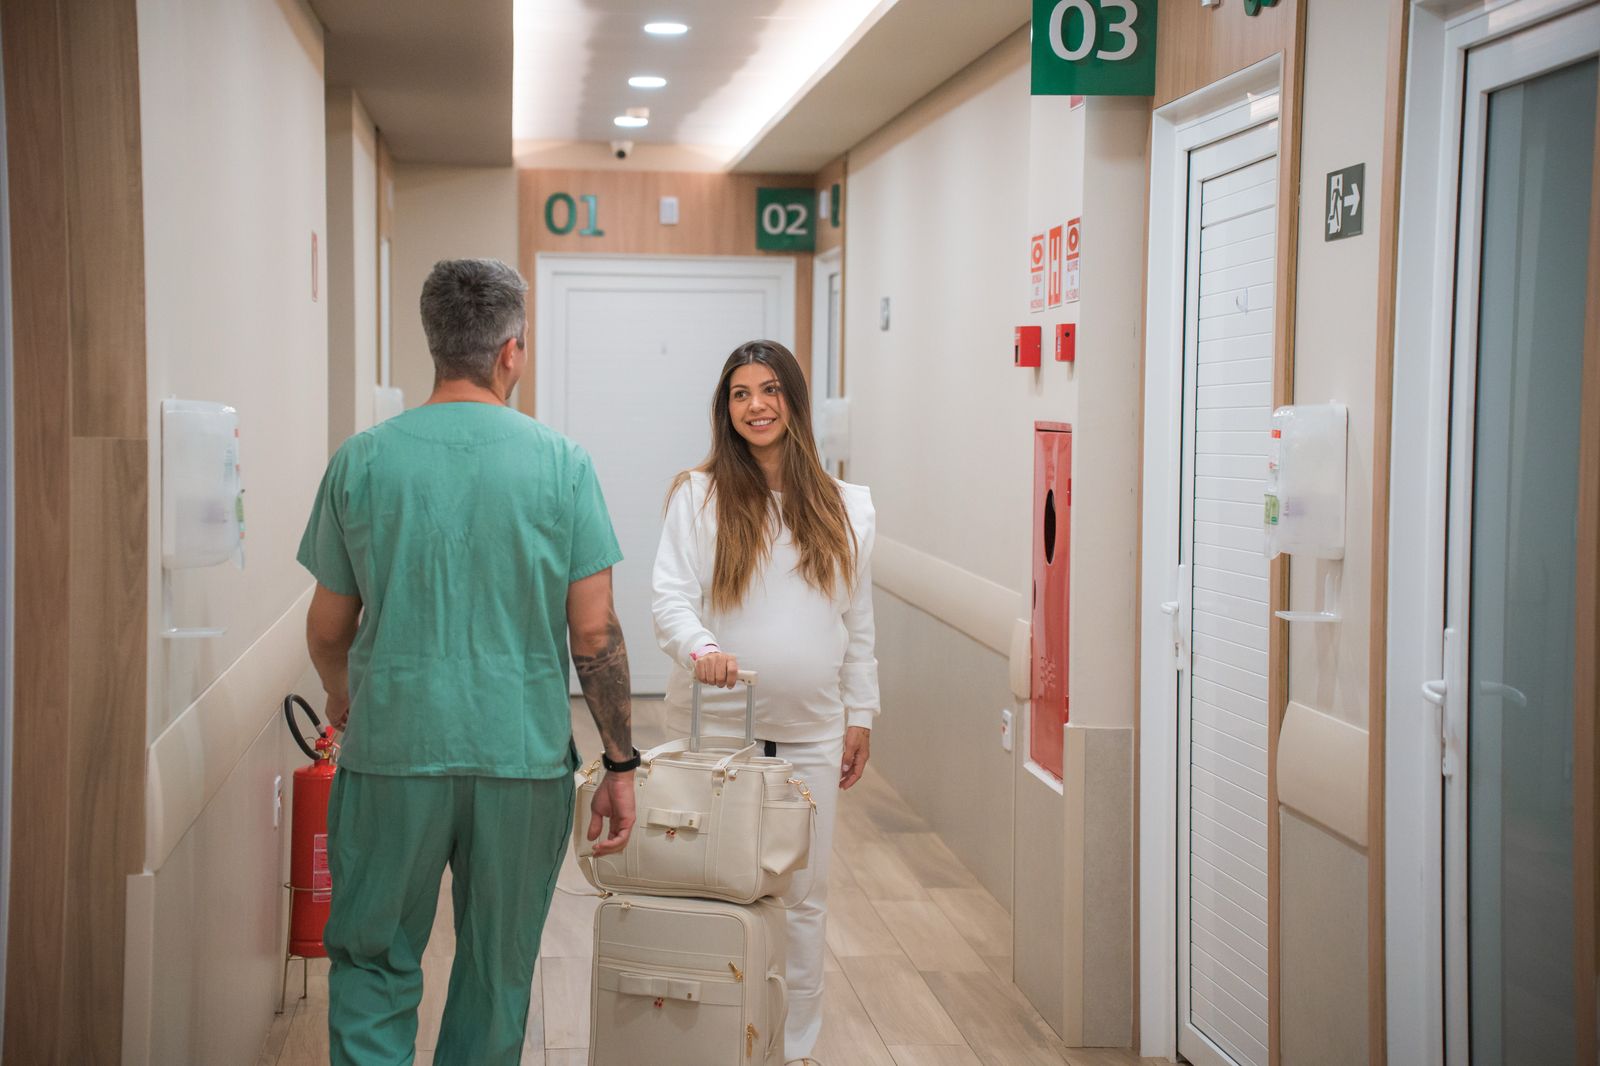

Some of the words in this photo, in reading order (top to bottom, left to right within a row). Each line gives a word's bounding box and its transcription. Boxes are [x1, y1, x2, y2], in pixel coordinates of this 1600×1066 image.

[1049, 0, 1138, 61] 03
[544, 192, 605, 237] 01
[761, 204, 808, 235] 02
